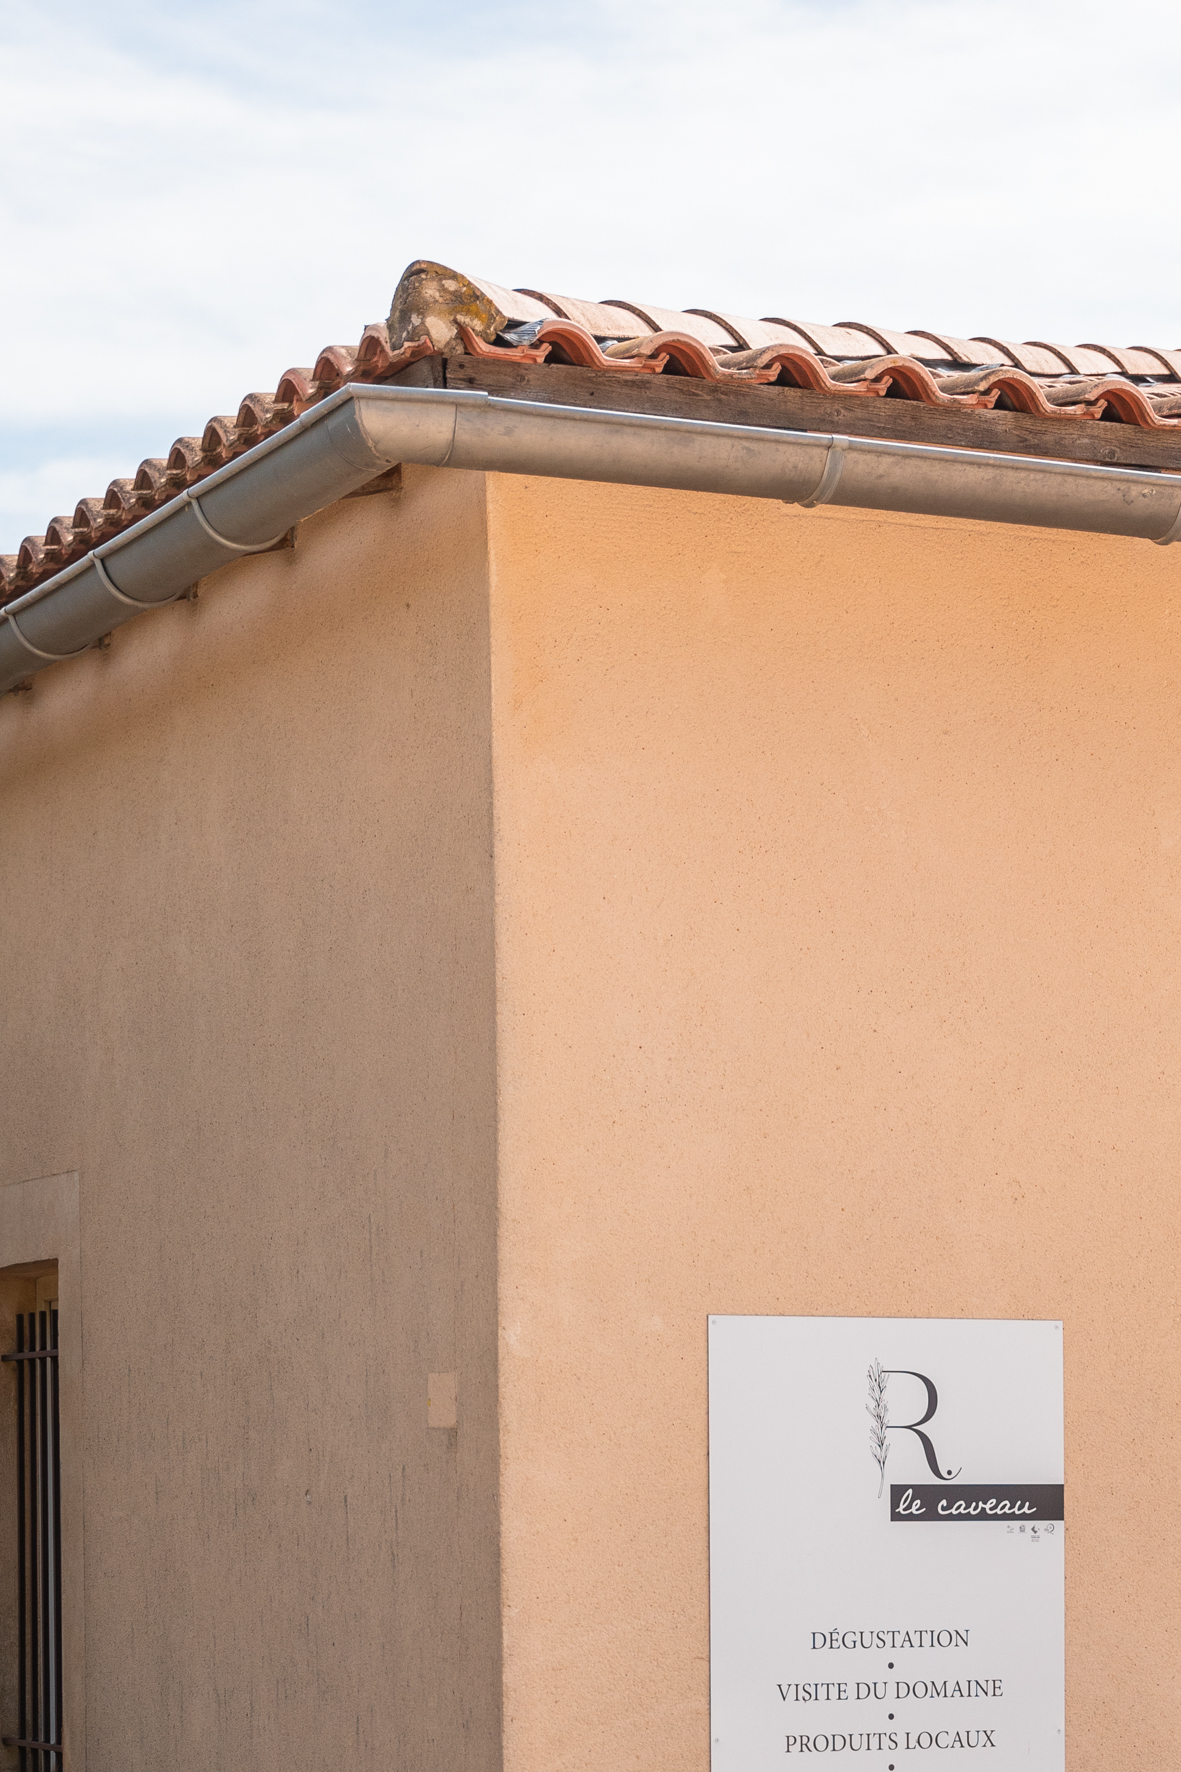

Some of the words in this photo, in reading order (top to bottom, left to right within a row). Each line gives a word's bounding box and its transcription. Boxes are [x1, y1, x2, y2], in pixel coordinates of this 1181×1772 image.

[894, 1488, 926, 1515] le
[937, 1498, 1037, 1516] caveau
[810, 1627, 970, 1650] DÉGUSTATION
[776, 1682, 849, 1703] VISITE
[854, 1681, 889, 1701] DU
[894, 1678, 1004, 1700] DOMAINE
[785, 1731, 899, 1753] PRODUITS
[904, 1729, 997, 1750] LOCAUX
